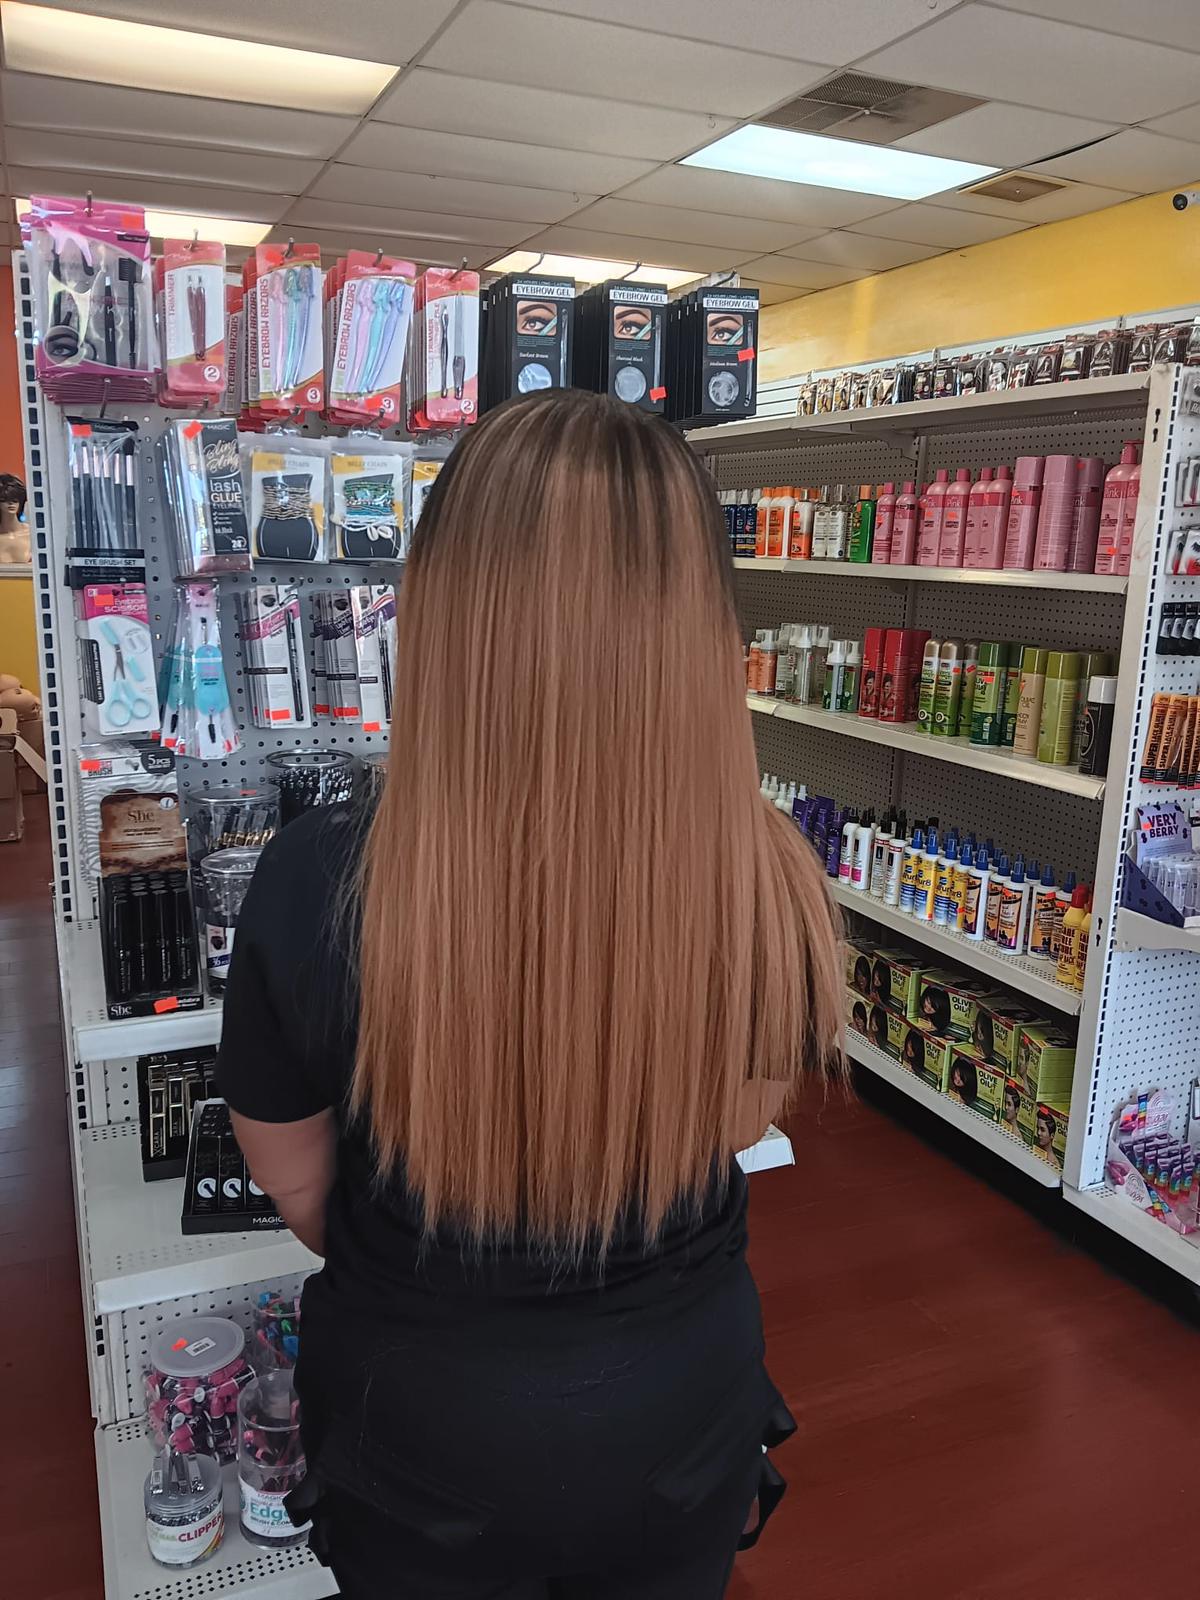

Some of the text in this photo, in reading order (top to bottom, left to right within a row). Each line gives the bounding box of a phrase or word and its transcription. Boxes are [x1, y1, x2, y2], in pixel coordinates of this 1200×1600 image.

[516, 285, 571, 296] EYEBROW GEL
[613, 291, 665, 303] EYEBROW GEL
[706, 299, 756, 308] EYEBROW GEL
[260, 279, 271, 368] EYEBROW RAZORS
[337, 283, 357, 370] EYEBROW RAZORS
[249, 290, 257, 378] EYEBROW RAZORS
[228, 315, 238, 394] EYEBROW RAZORS
[207, 367, 217, 378] 2
[310, 389, 318, 401] 3
[384, 398, 392, 409] 3
[463, 400, 472, 410] 2
[203, 438, 238, 459] Bling
[206, 454, 239, 473] Bling
[209, 479, 242, 494] lash
[210, 492, 242, 503] GLUE
[147, 754, 156, 765] 5
[1146, 742, 1158, 767] SUPER
[1158, 744, 1170, 768] SUPER
[1181, 747, 1192, 772] SUPER
[127, 809, 154, 821] She
[1146, 812, 1177, 828] VERY
[1149, 824, 1180, 839] BERRY
[891, 970, 906, 981] OLIVE
[892, 977, 903, 987] OIL
[951, 996, 974, 1009] OLIVE
[953, 1004, 968, 1013] OIL
[110, 1005, 132, 1016] She
[888, 1017, 903, 1029] OLIVE
[993, 1023, 1009, 1037] OLIVE
[995, 1031, 1006, 1042] OIL
[925, 1042, 940, 1055] OLIVE
[978, 1070, 998, 1084] OLIVE
[980, 1078, 993, 1089] OIL
[252, 1215, 285, 1224] MAGIC
